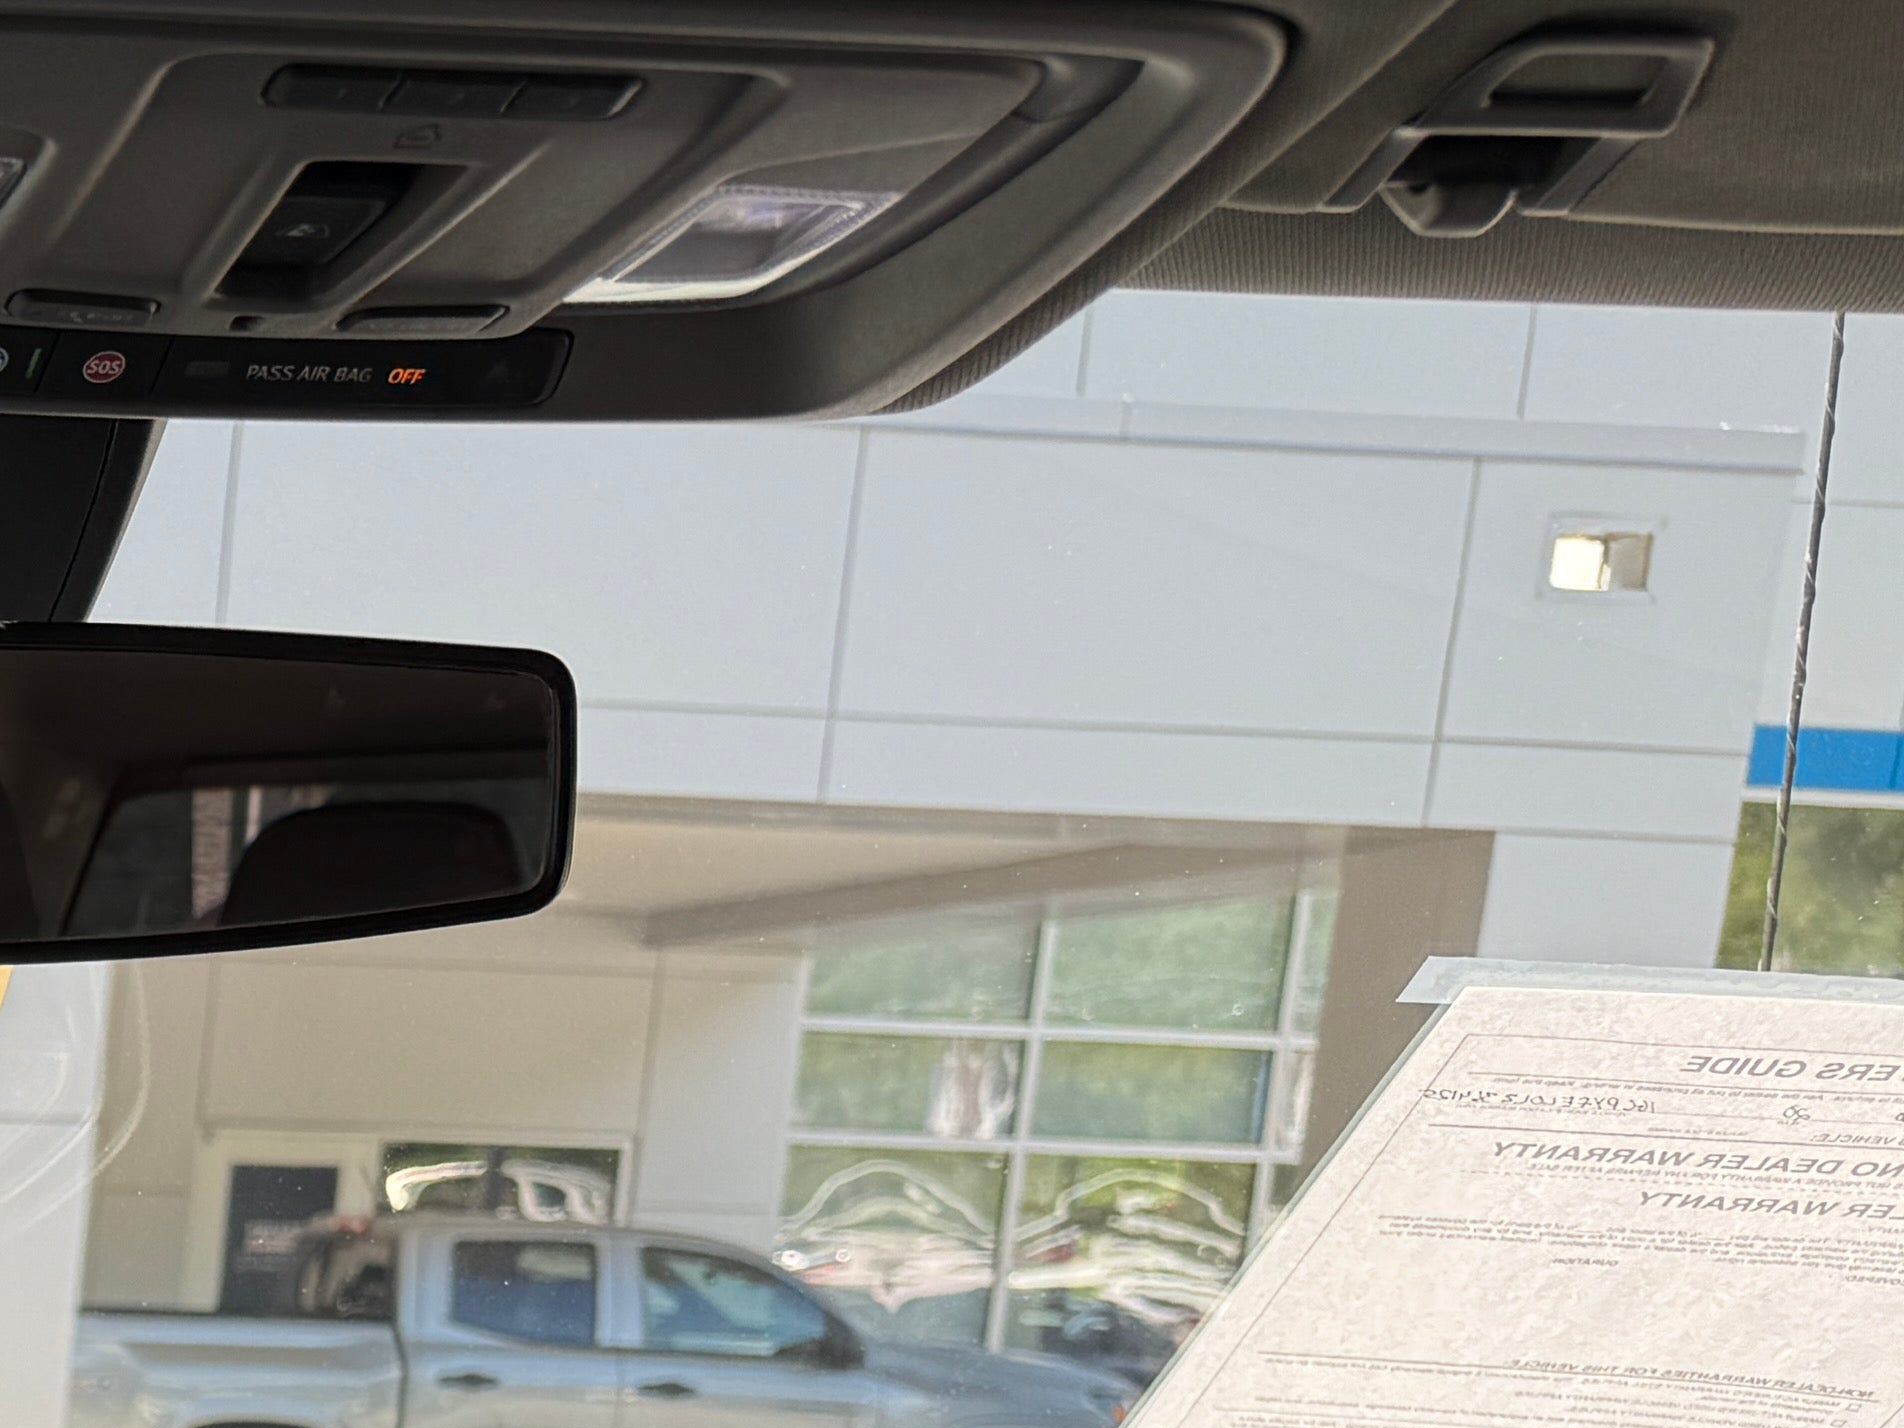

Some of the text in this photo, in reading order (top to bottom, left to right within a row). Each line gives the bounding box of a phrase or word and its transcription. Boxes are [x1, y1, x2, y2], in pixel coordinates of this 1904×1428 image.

[85, 359, 123, 376] SOS
[246, 364, 427, 386] PASS AIR BAG OFF
